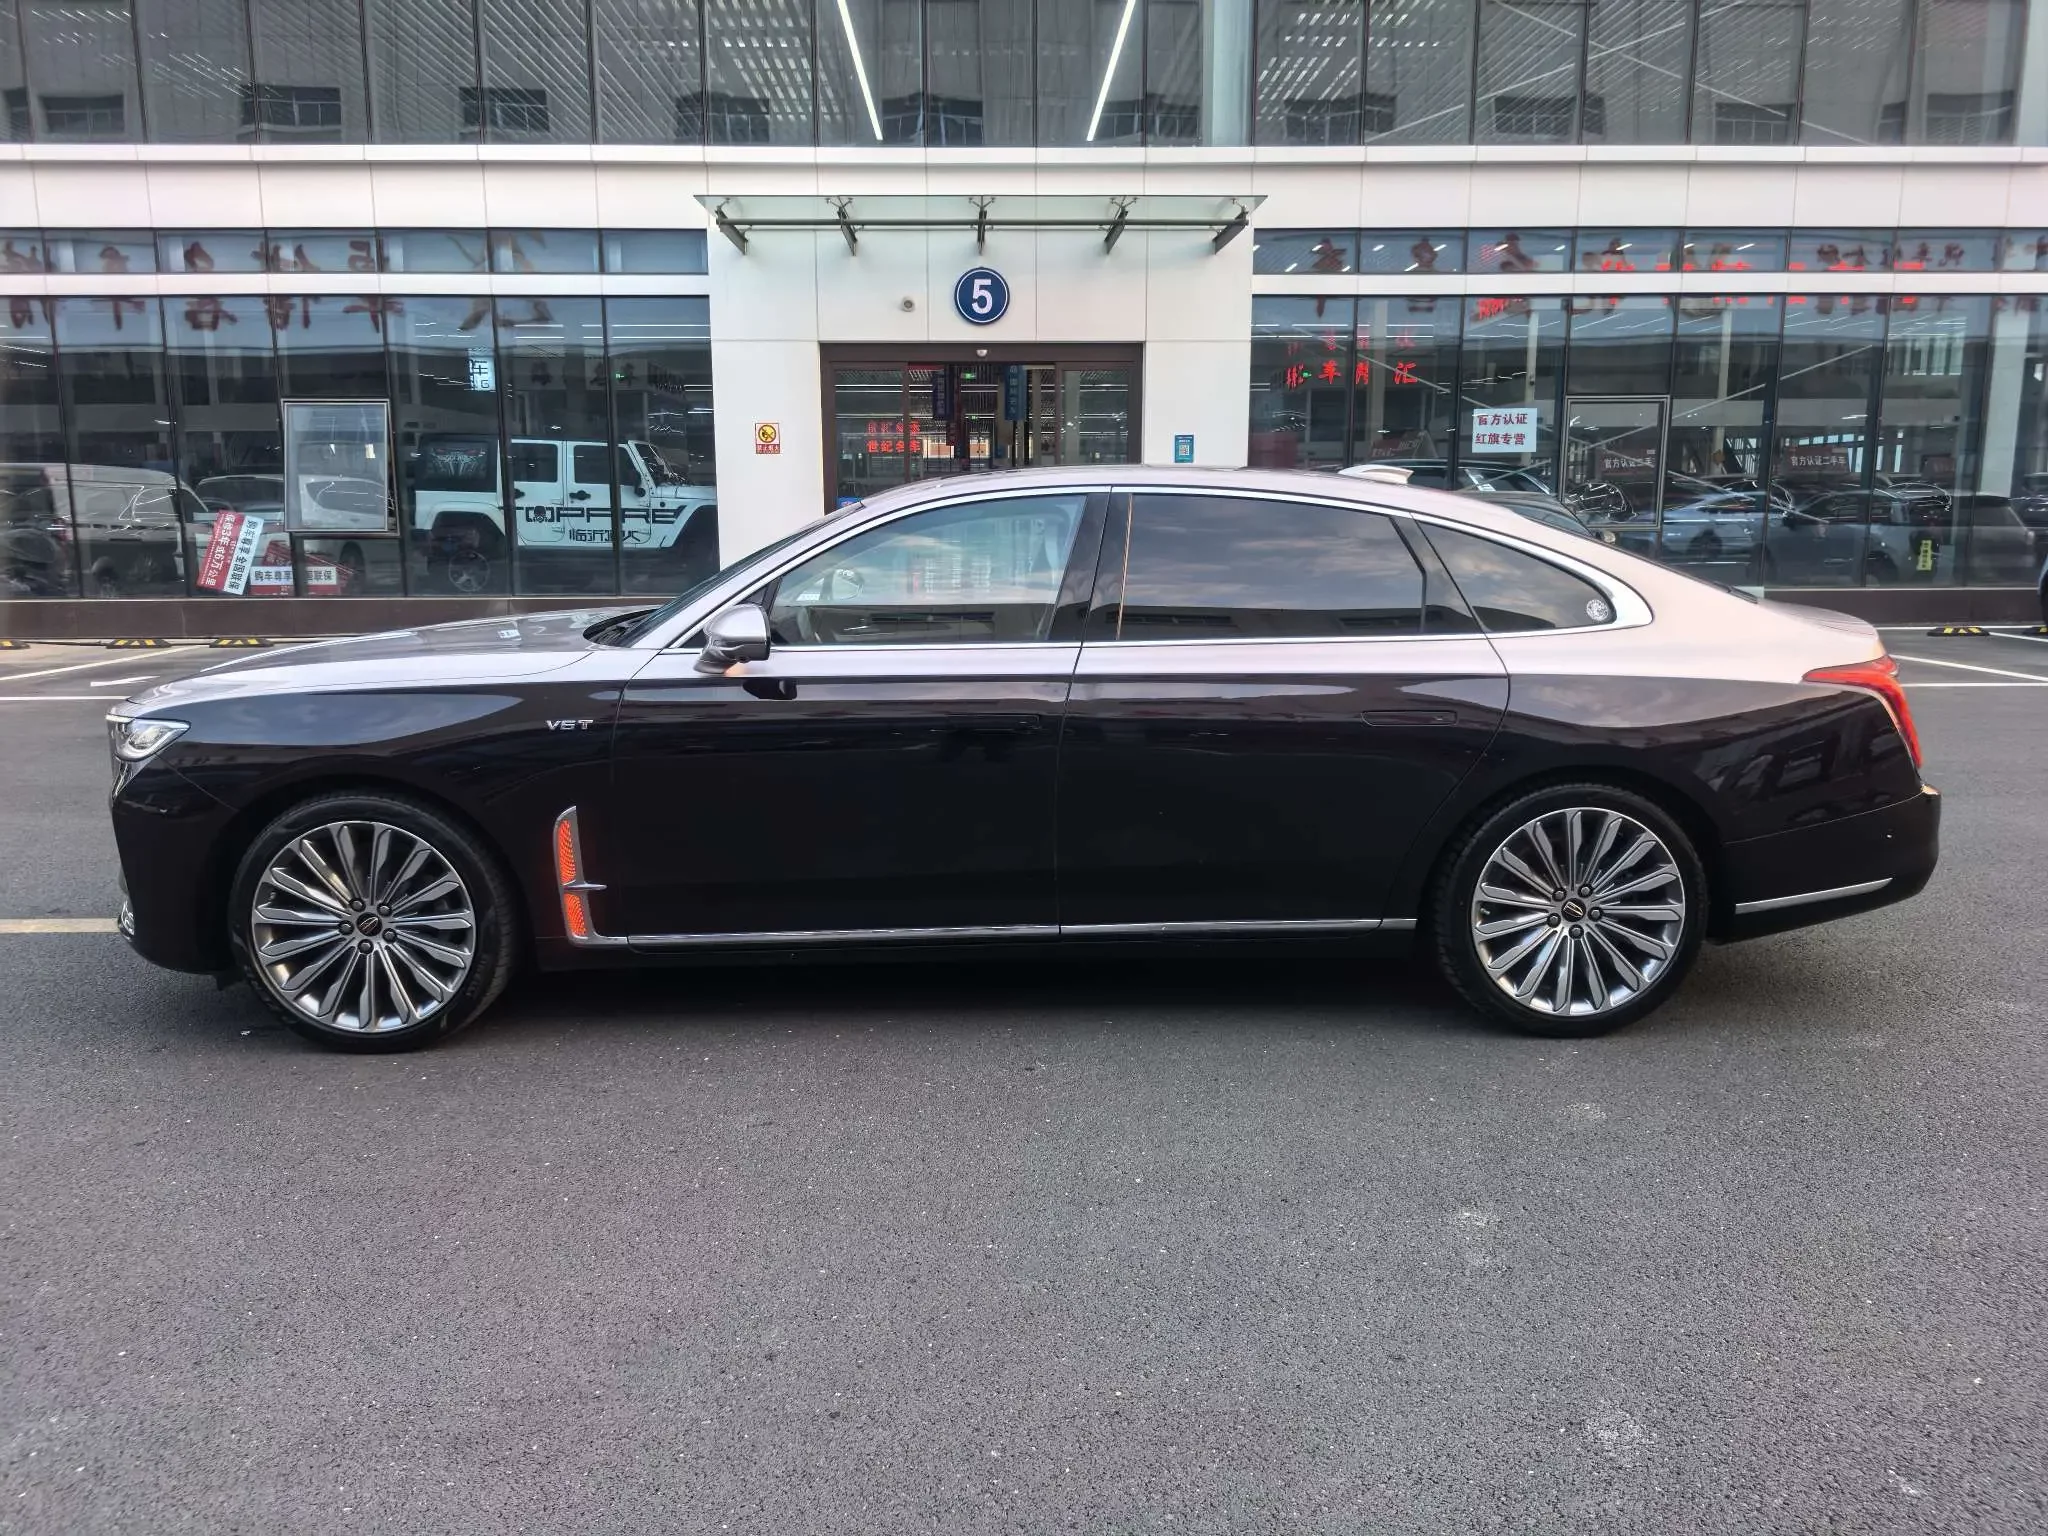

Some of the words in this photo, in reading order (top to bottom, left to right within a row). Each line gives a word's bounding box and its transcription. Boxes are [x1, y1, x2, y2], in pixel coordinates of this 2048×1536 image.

[972, 278, 993, 314] 5
[1477, 413, 1528, 426] 官方认证
[1475, 432, 1526, 446] 红旗专营
